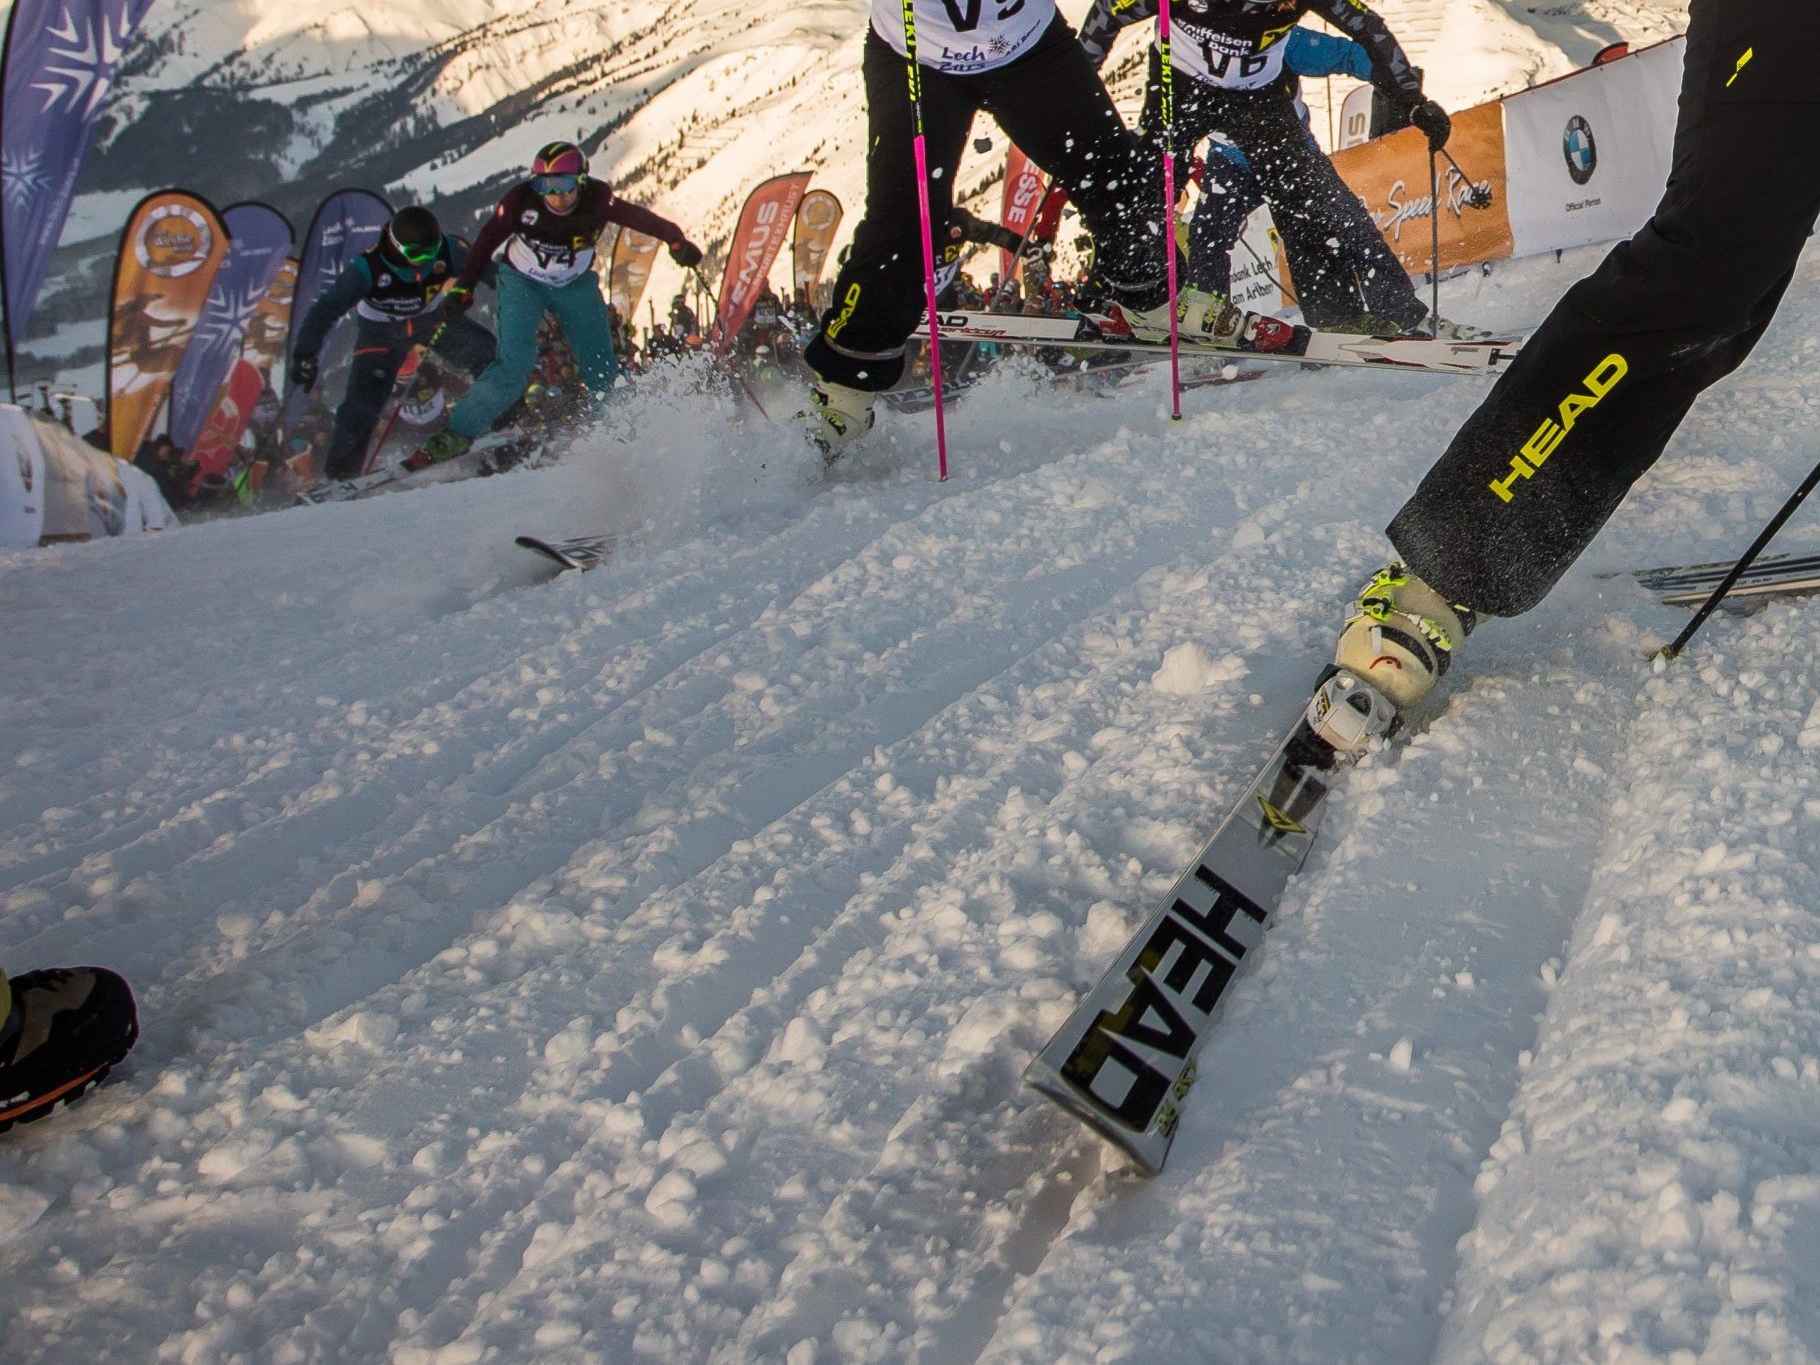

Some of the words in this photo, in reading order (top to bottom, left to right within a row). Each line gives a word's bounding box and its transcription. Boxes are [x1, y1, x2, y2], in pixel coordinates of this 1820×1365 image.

[941, 47, 986, 62] Lech
[1489, 353, 1628, 503] HEAD
[1061, 864, 1267, 1133] HEAD
